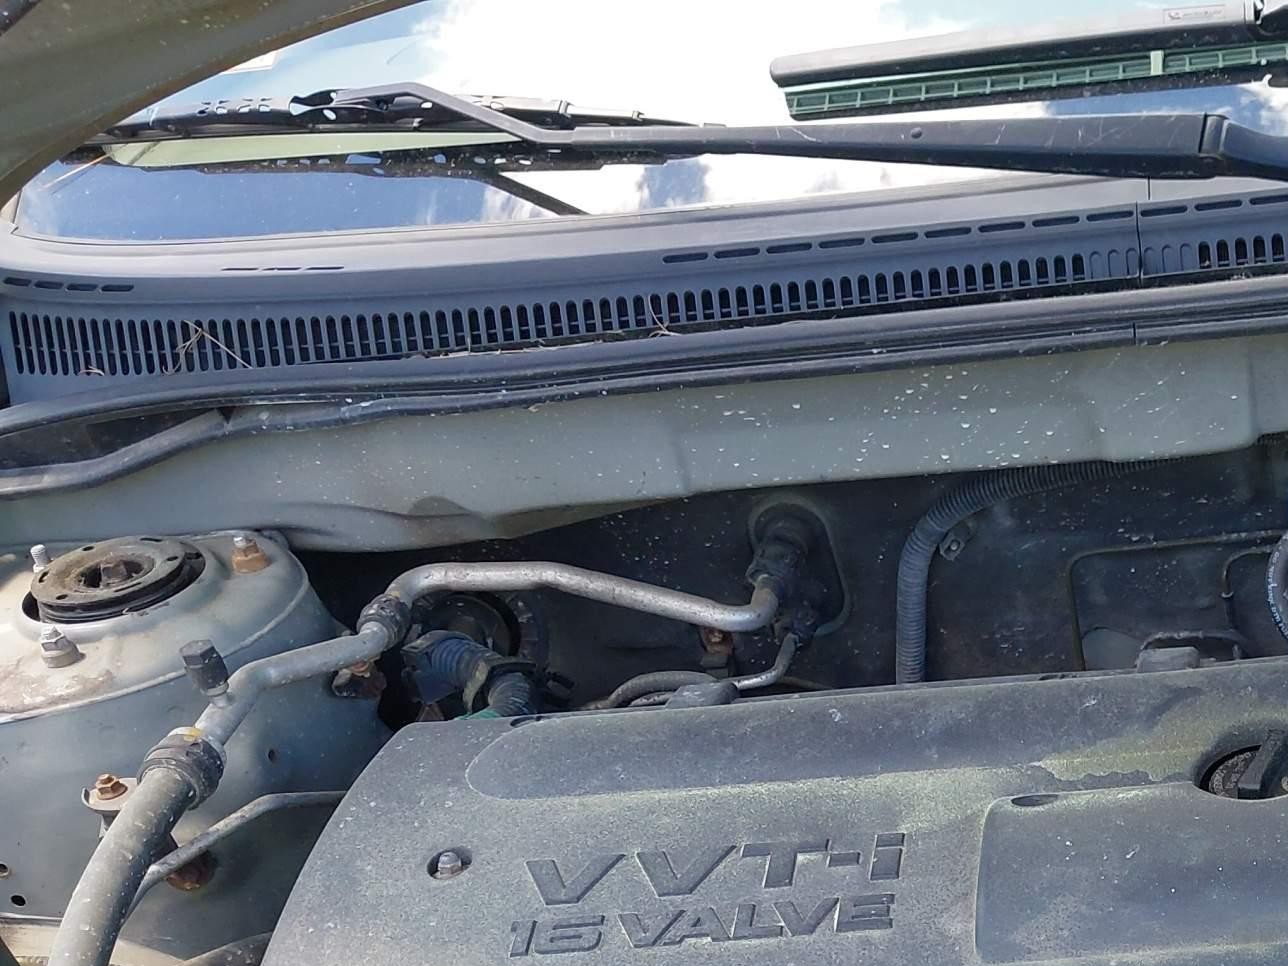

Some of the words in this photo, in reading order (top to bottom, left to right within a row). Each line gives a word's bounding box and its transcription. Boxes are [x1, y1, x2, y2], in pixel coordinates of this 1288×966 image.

[525, 832, 905, 906] VVT-i
[509, 914, 606, 958] 16
[617, 893, 896, 948] VALVE
